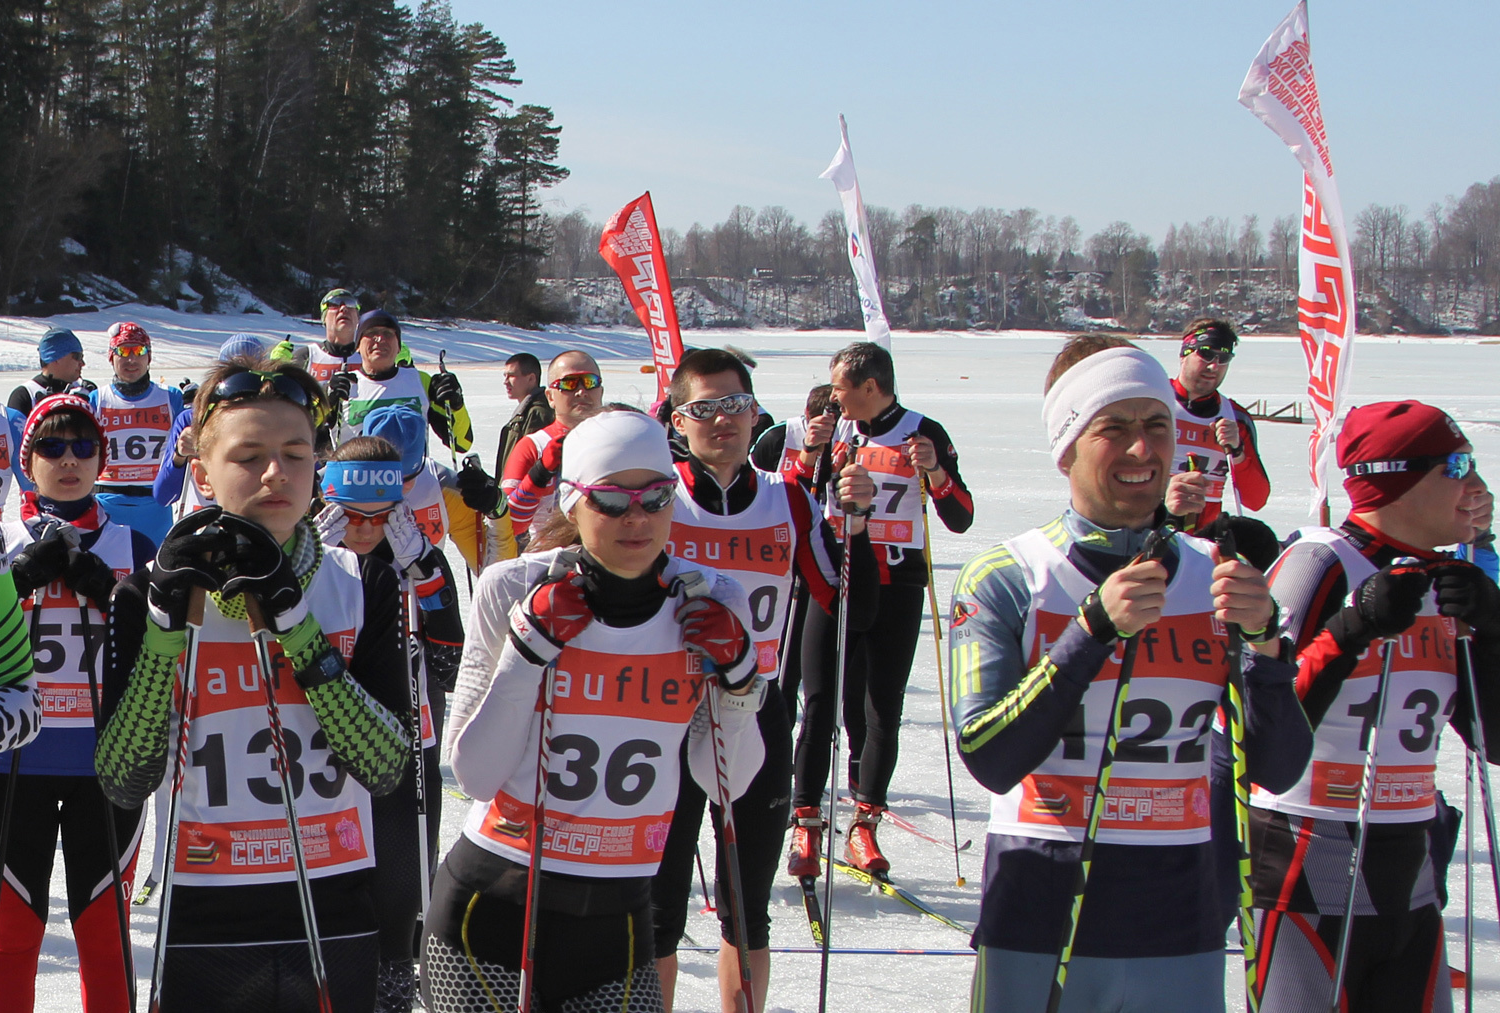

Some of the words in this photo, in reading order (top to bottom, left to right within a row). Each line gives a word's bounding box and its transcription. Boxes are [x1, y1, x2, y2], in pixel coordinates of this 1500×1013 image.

[110, 435, 167, 460] 167
[1372, 460, 1408, 474] BLIZ
[955, 629, 972, 641] IBU
[553, 665, 706, 706] auflex
[1062, 698, 1219, 764] 122
[1347, 688, 1457, 753] 13
[192, 727, 348, 808] 133
[546, 733, 663, 807] 36
